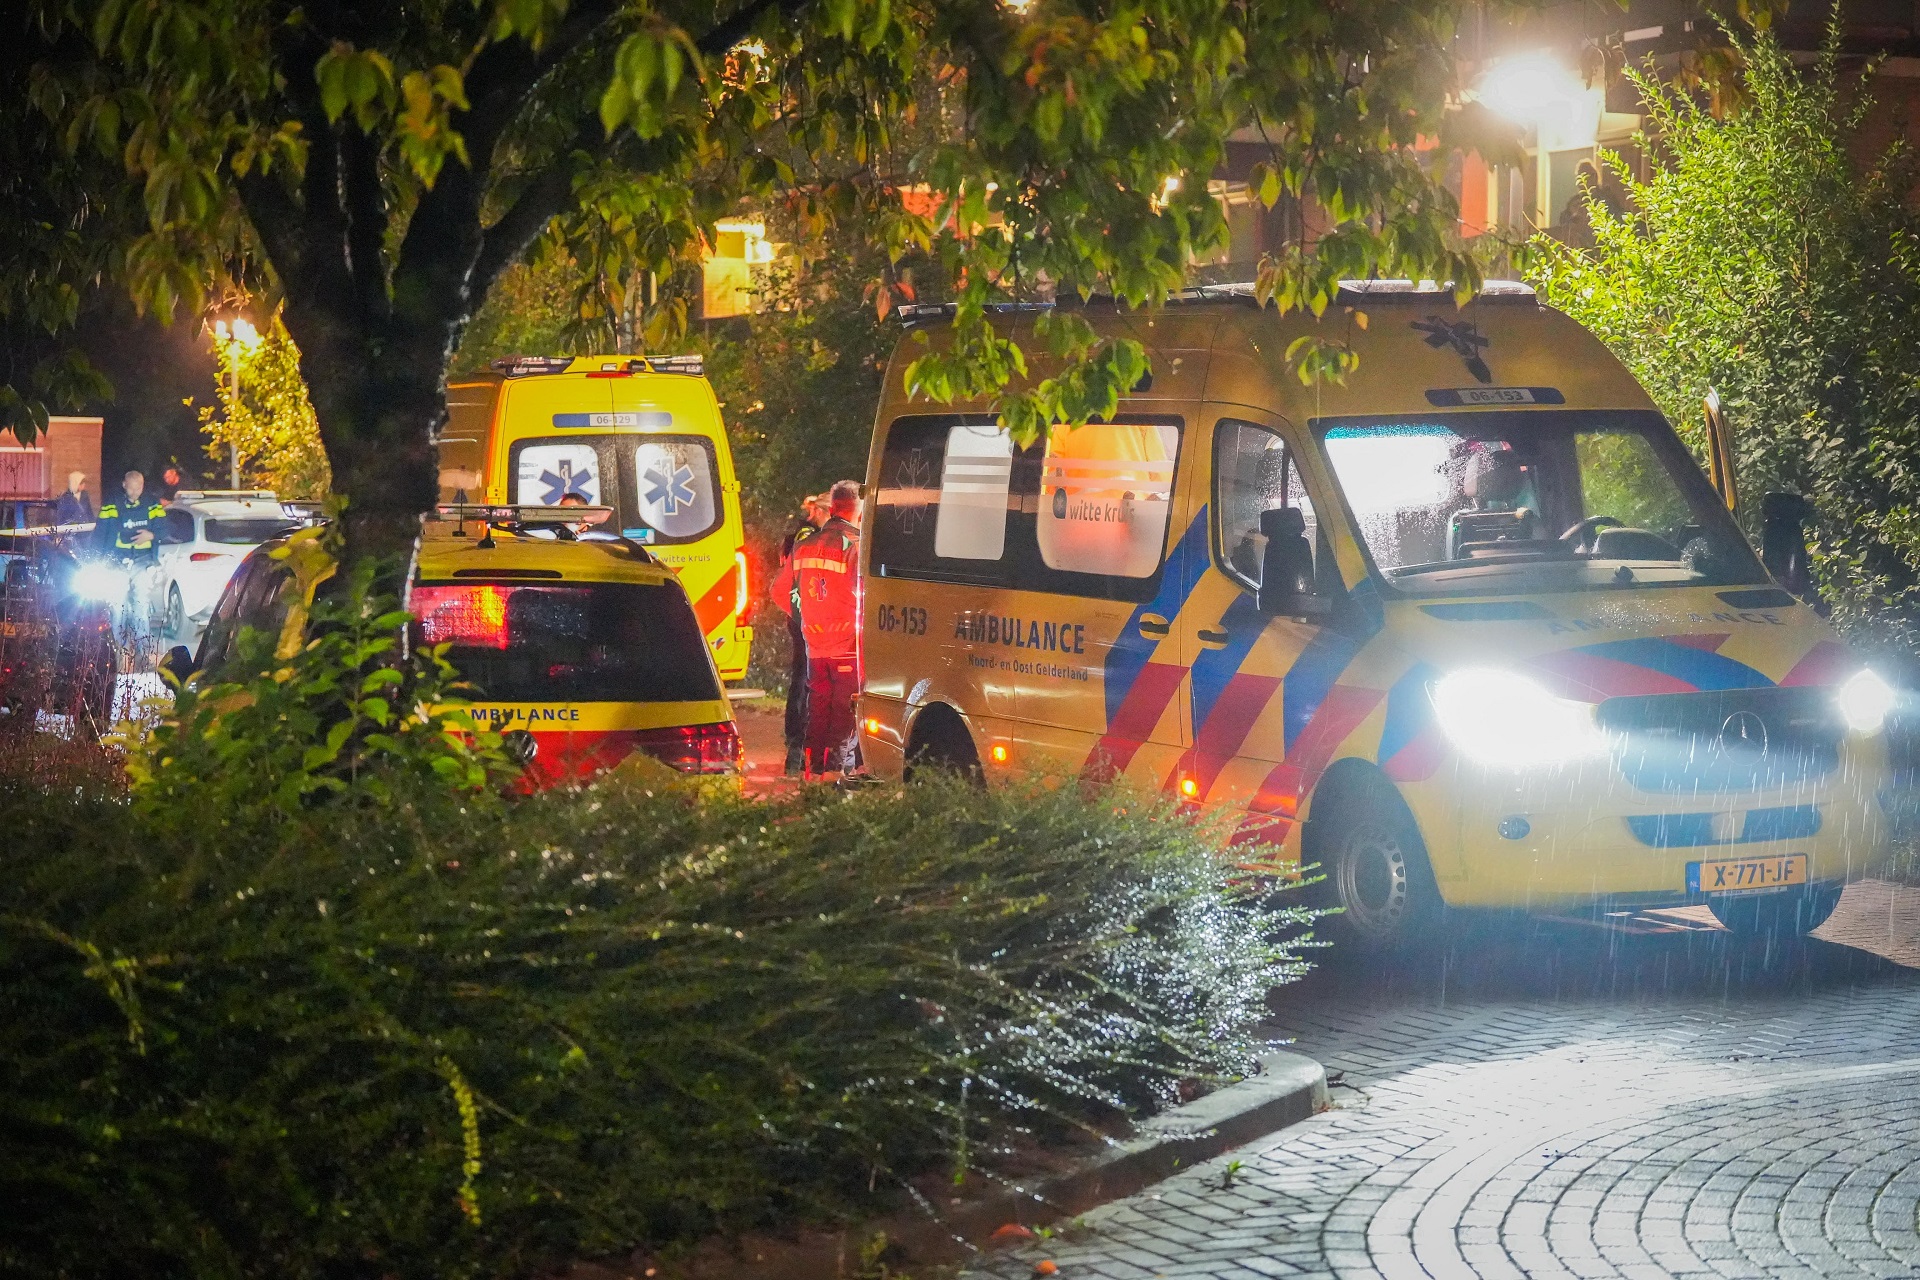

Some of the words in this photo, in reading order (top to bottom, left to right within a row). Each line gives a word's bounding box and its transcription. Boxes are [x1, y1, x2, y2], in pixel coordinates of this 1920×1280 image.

[1469, 390, 1524, 402] 06-153
[596, 415, 631, 425] 06-129
[1069, 499, 1102, 522] witte
[661, 554, 686, 563] witte
[688, 553, 711, 562] kruis
[878, 603, 928, 636] 06-153
[954, 614, 1085, 655] AMBULANCE
[1000, 660, 1011, 671] en
[1013, 659, 1034, 675] Oost
[1036, 663, 1088, 682] Gelderland
[459, 708, 580, 721] MBULANCE
[1713, 860, 1795, 887] X-771-JF
[1689, 880, 1699, 888] NL
